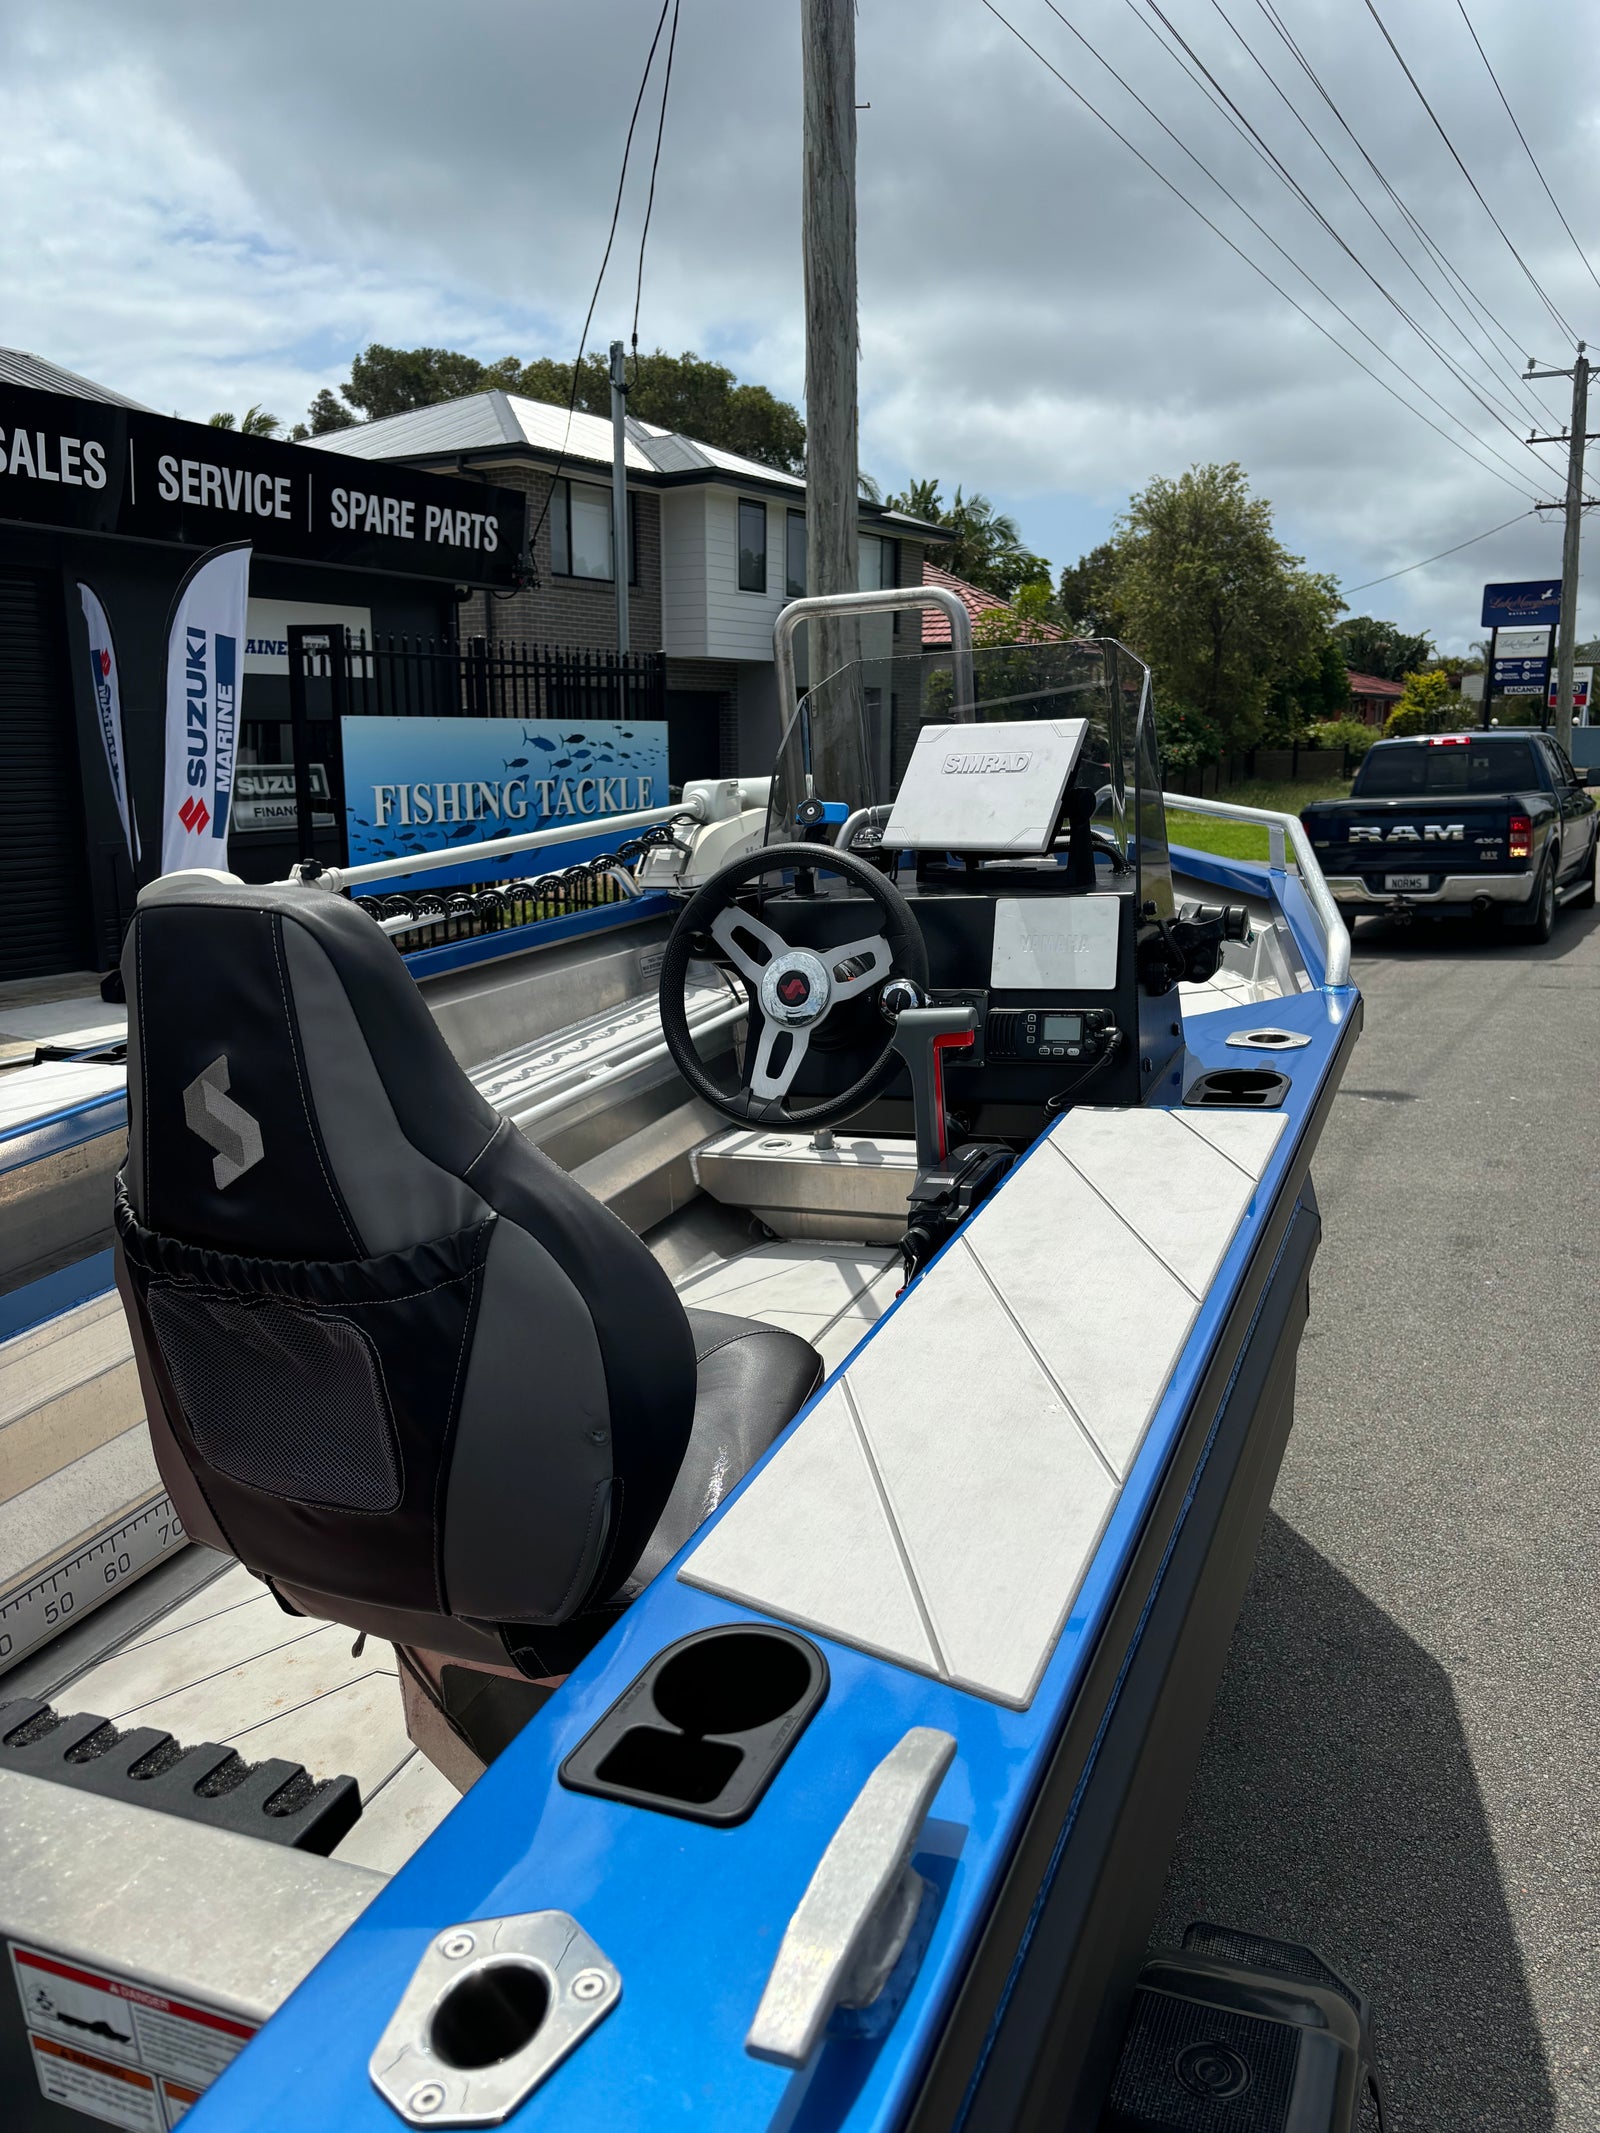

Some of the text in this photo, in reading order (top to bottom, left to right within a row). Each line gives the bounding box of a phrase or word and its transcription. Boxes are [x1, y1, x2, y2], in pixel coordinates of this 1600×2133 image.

[158, 455, 291, 520] SERVICE
[330, 487, 499, 552] SPARE PARTS
[245, 639, 288, 655] AINE
[186, 626, 208, 788] SUZUKI
[216, 682, 233, 793] MARINE
[944, 753, 1029, 773] SIMRAD
[237, 774, 320, 795] SUZUI
[371, 776, 654, 828] FISHING TACKLE
[1348, 824, 1465, 843] RAM
[1019, 934, 1089, 953] YAMAHA
[44, 1591, 74, 1624] 50
[104, 1552, 131, 1583] 60
[158, 1517, 184, 1545] 70
[120, 1985, 170, 2010] DANGER
